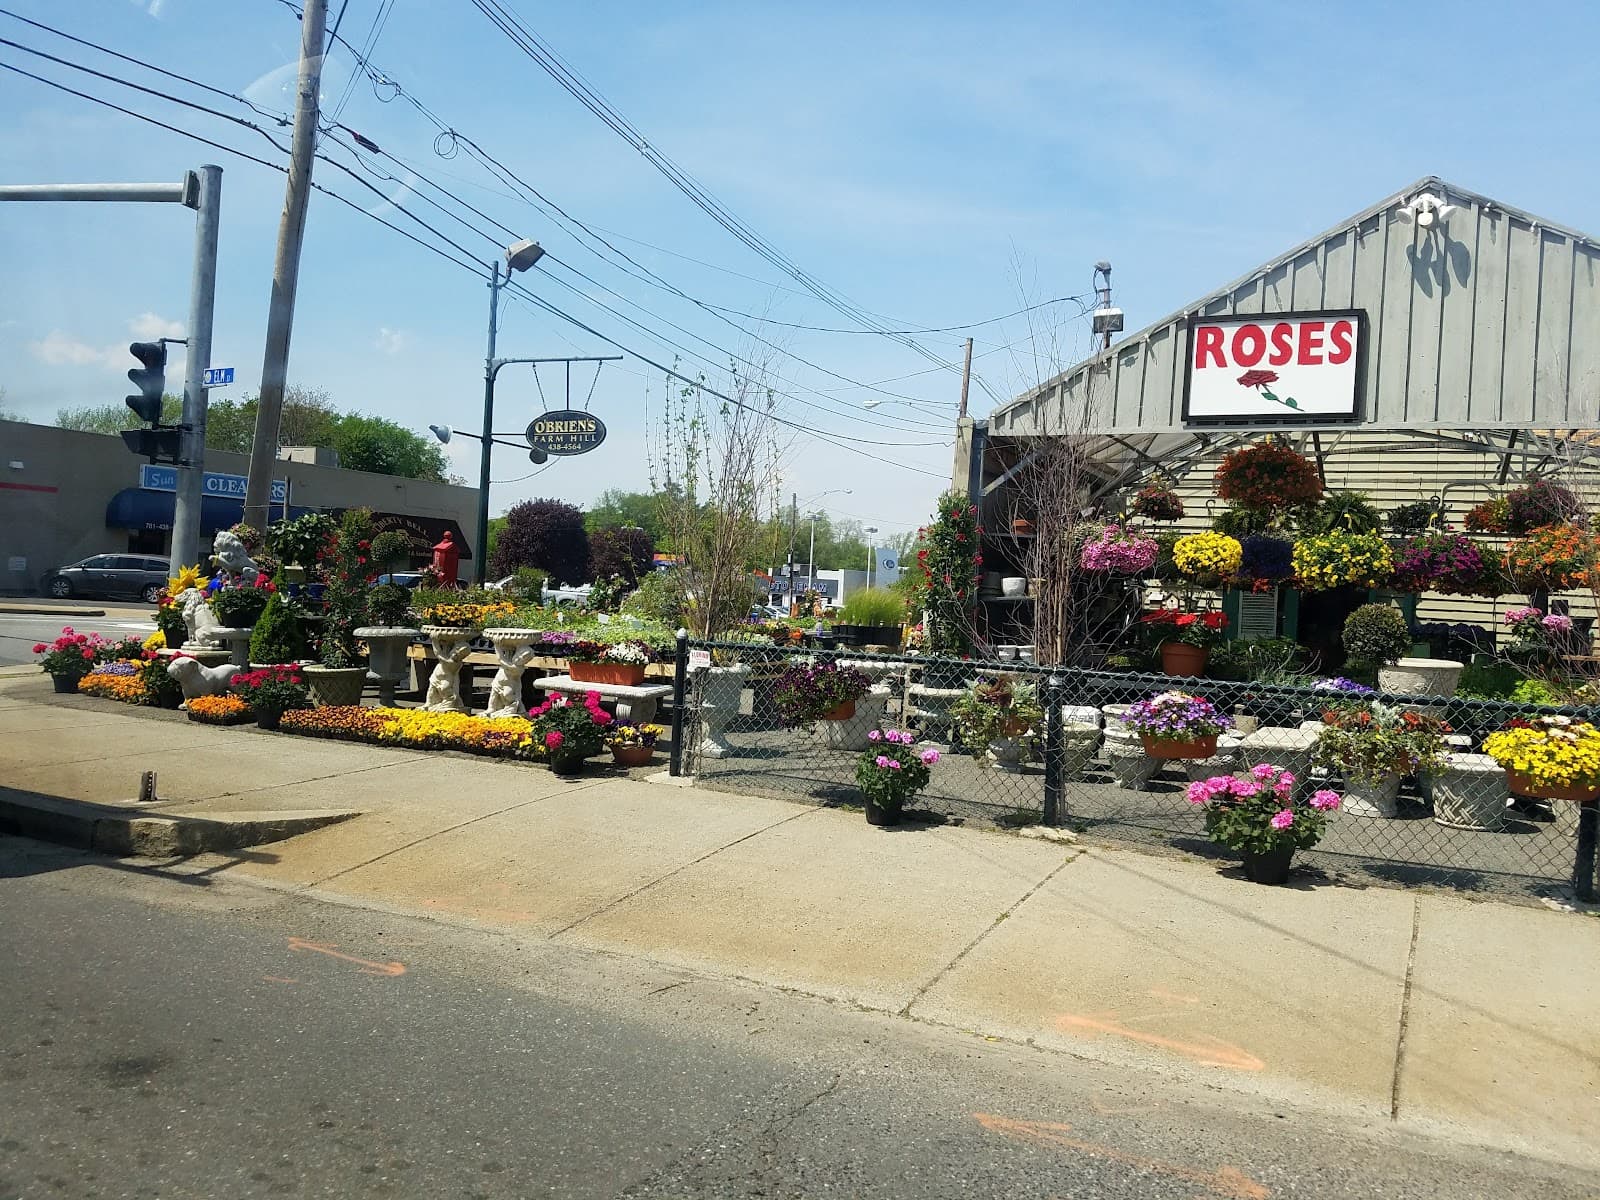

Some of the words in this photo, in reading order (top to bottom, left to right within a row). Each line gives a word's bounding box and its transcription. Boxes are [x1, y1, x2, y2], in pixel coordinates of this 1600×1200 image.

[1195, 320, 1353, 369] ROSES
[214, 370, 225, 383] ELM
[535, 419, 597, 433] O'BRIEN'S
[570, 434, 597, 442] HILL
[548, 443, 582, 451] 438-4564
[151, 472, 174, 487] Sun
[206, 478, 285, 498] CLEARS
[374, 517, 403, 533] LIBERTY
[406, 519, 429, 538] BELL
